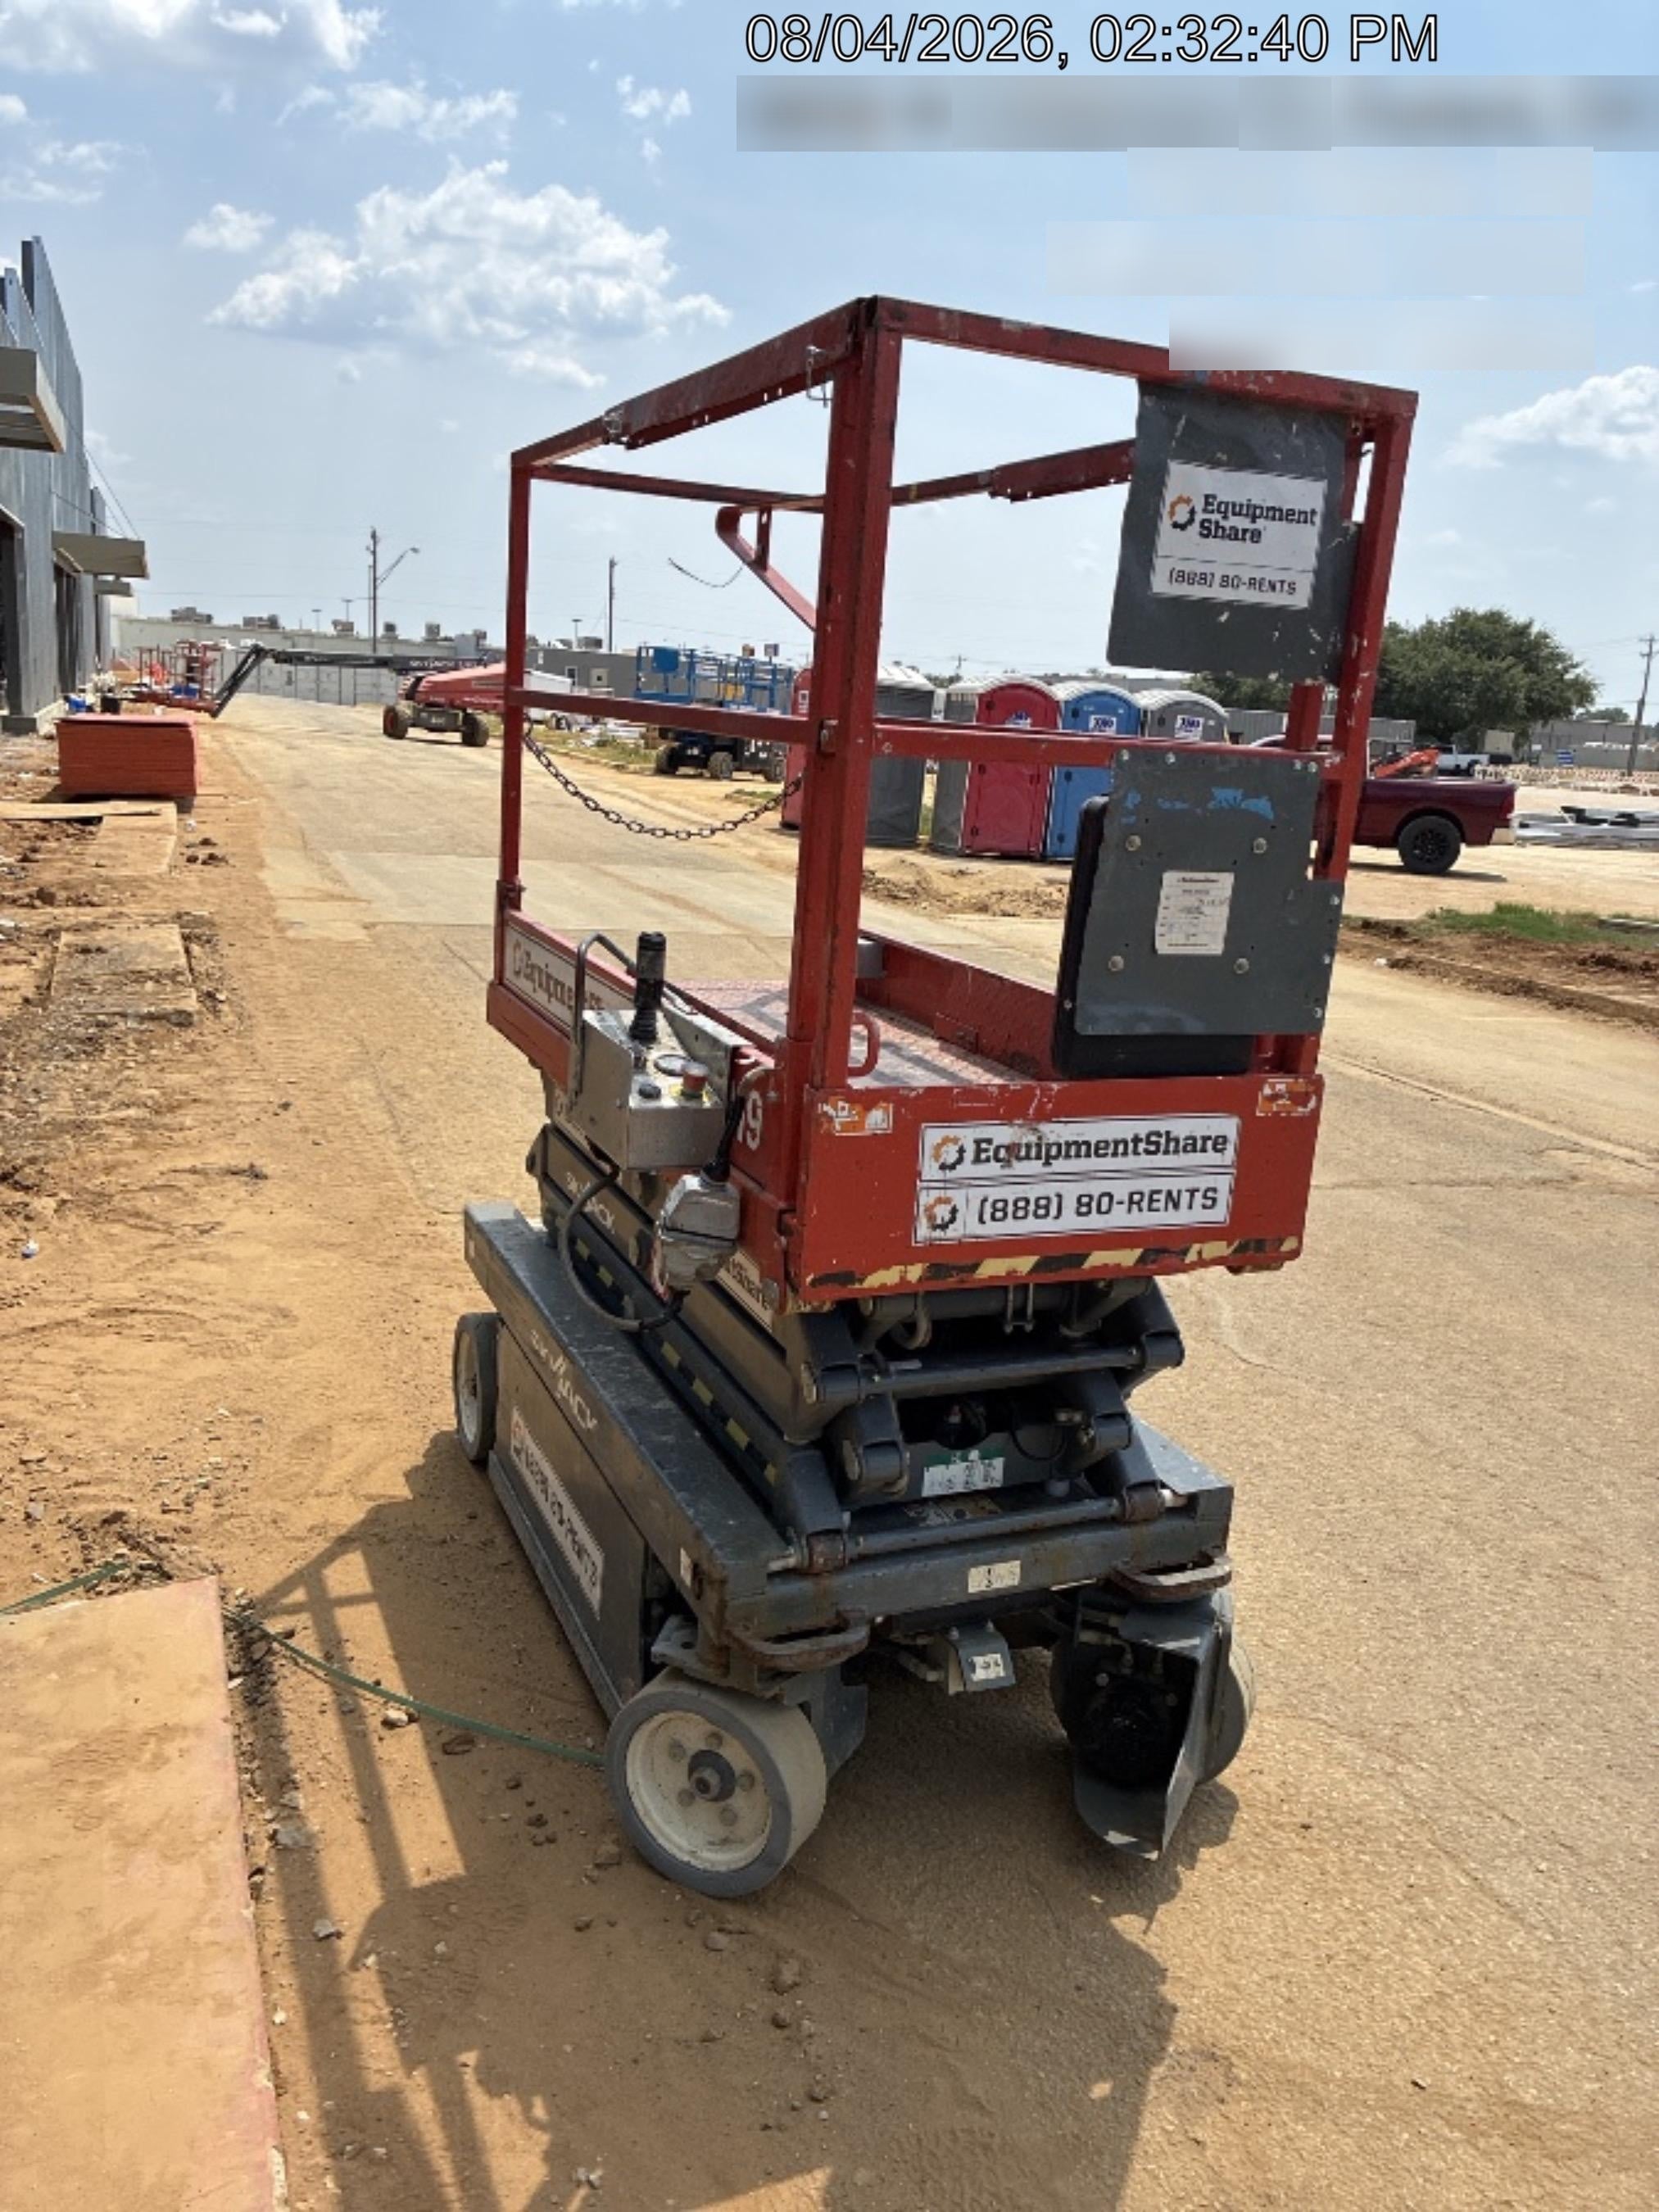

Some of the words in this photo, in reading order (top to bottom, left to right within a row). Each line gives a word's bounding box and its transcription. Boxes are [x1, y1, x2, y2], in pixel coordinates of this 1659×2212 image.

[1201, 493, 1318, 527] Equipment
[1198, 518, 1262, 544] Share
[1168, 567, 1215, 588] (888)
[1219, 574, 1297, 596] 80-RENTS
[971, 1130, 1229, 1169] EquipmentShare
[977, 1192, 1063, 1225] (888)
[1075, 1187, 1219, 1218] 80-RENTS
